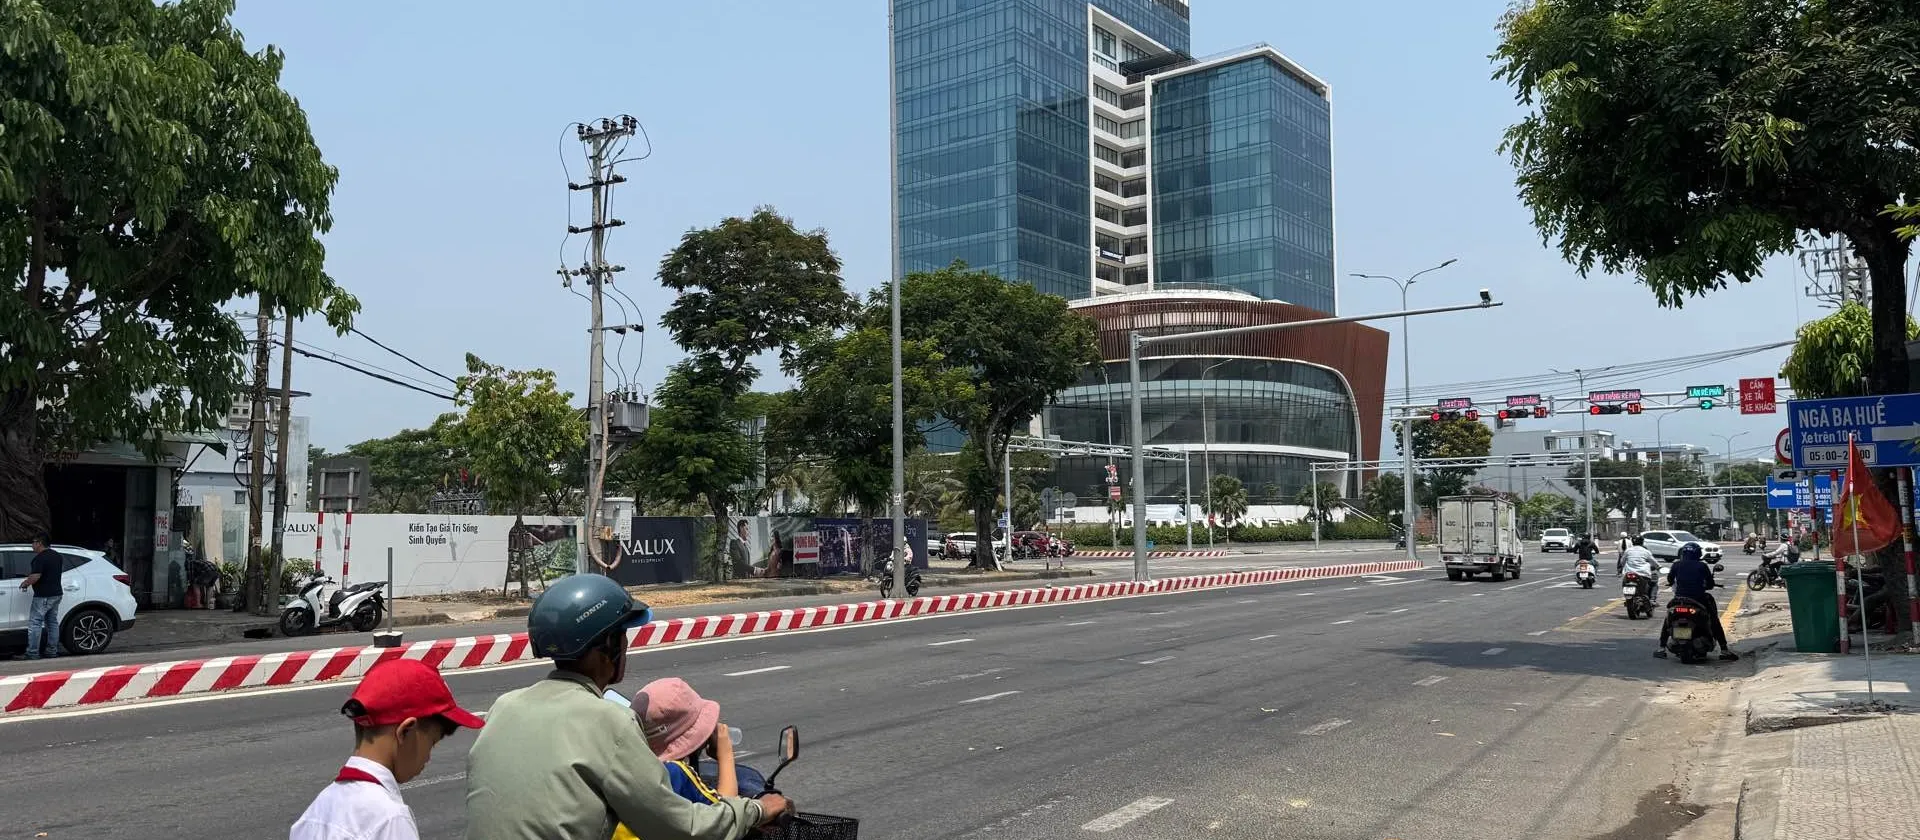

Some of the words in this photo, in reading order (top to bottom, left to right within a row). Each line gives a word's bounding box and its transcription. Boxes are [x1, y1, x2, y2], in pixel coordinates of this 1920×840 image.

[1535, 407, 1546, 417] 47
[1629, 403, 1640, 413] 47
[1798, 405, 1830, 429] NGÃ
[1832, 406, 1853, 427] BA
[1855, 396, 1887, 425] HUẾ
[1466, 410, 1477, 420] 47
[1836, 429, 1863, 443] 105t
[426, 523, 438, 534] Tạo
[439, 523, 451, 533] Giá
[408, 535, 424, 545] Sinh
[575, 599, 608, 624] HONDA
